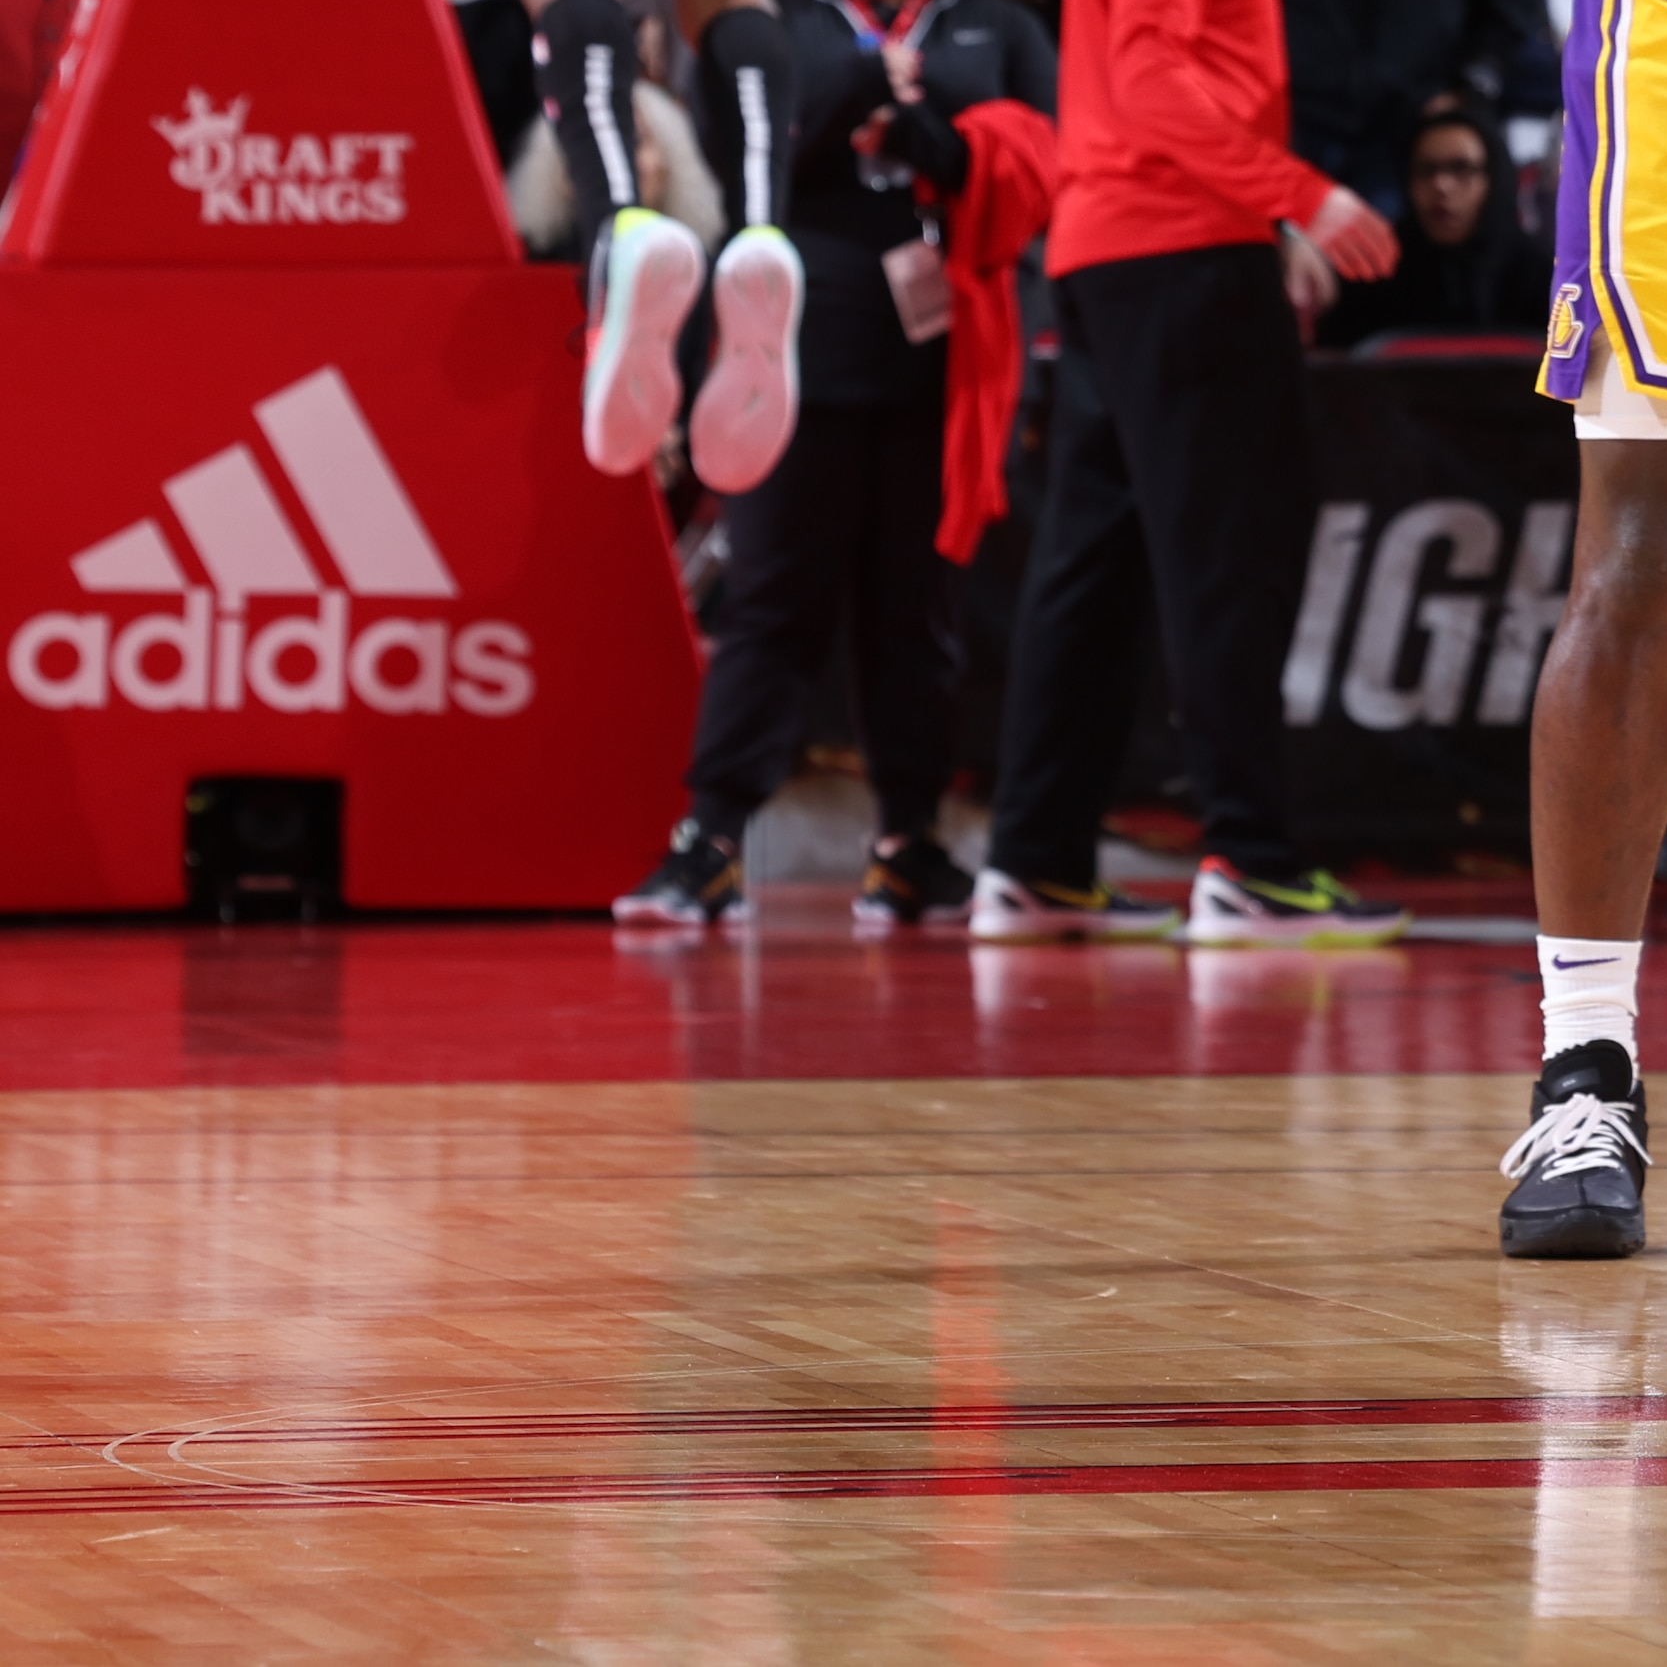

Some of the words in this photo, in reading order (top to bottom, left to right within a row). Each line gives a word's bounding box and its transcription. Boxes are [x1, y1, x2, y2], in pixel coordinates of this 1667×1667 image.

[169, 134, 414, 191] DRAFT
[201, 182, 407, 225] KINGS
[6, 589, 537, 718] adidas
